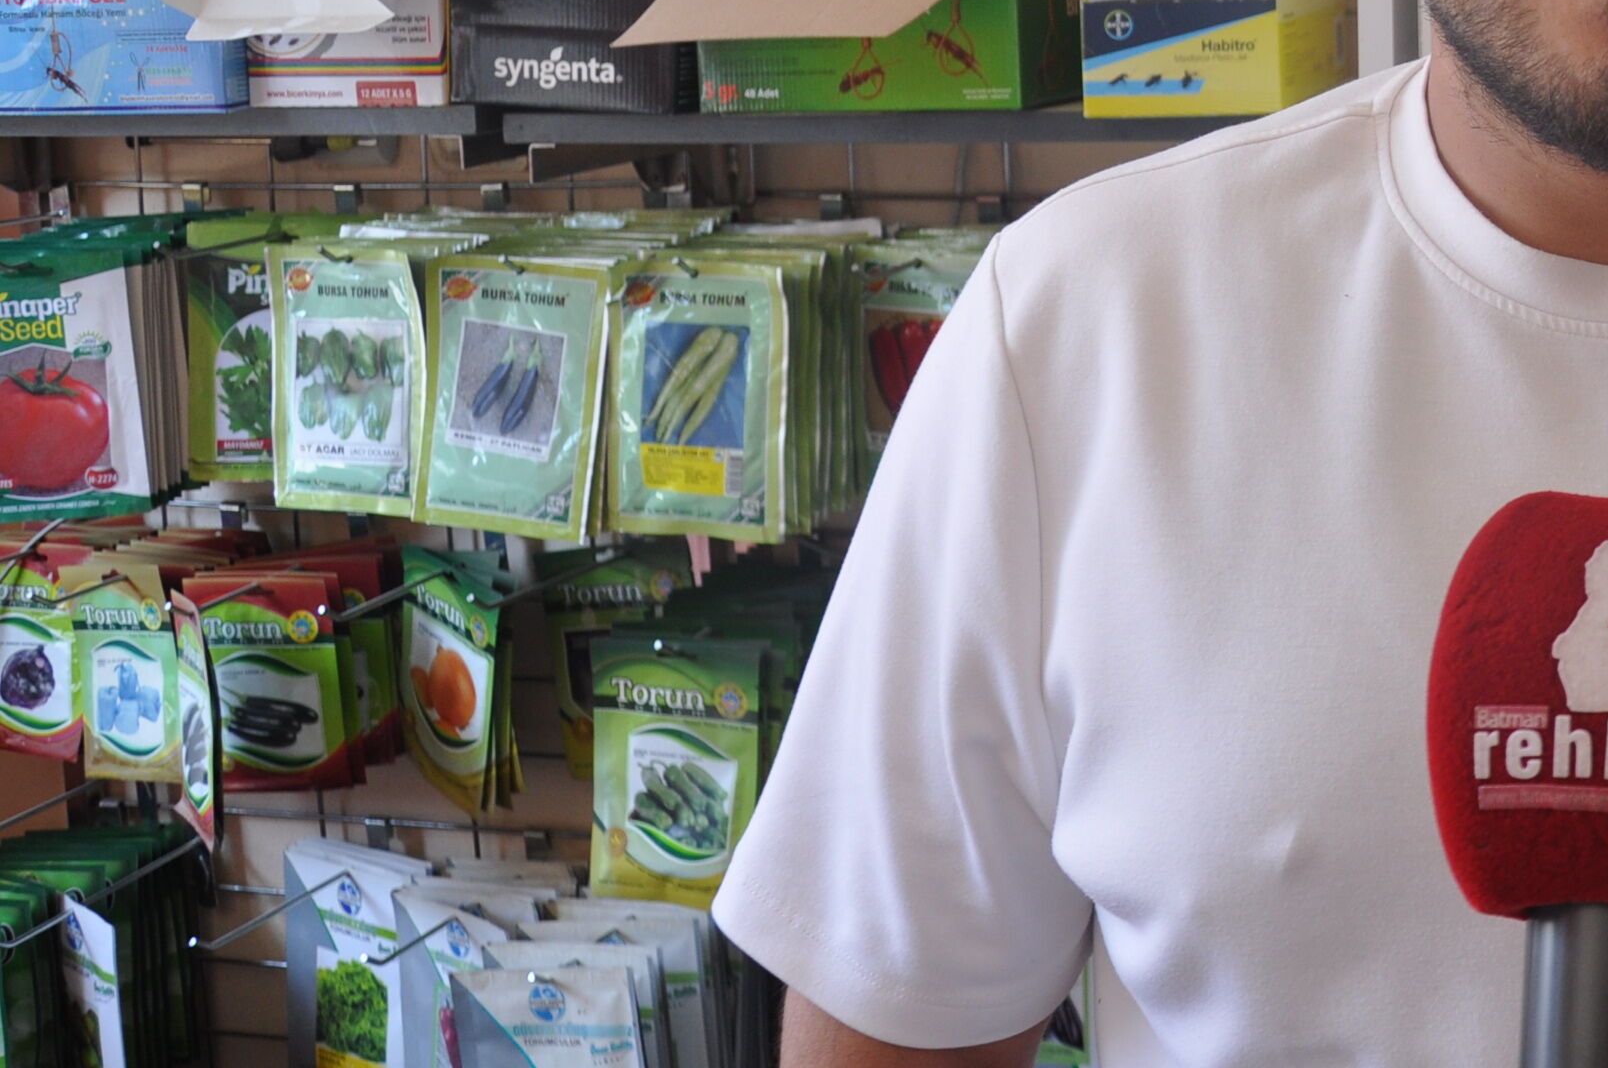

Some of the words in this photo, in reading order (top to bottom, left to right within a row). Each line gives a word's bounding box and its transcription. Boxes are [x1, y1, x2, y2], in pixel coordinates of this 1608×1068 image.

[1201, 39, 1255, 53] Habitro
[493, 54, 616, 89] syngenta
[361, 88, 369, 98] 12
[371, 88, 391, 98] ADET
[757, 87, 780, 100] Adet
[228, 267, 269, 295] Pin
[318, 285, 348, 298] BURSA
[351, 284, 389, 299] TOHUM
[481, 288, 522, 304] BURSA
[524, 293, 566, 308] TOHUM
[702, 293, 746, 307] TOHUM
[0, 315, 63, 341] Seed
[558, 582, 643, 605] Torun
[80, 604, 139, 625] Torun
[416, 584, 466, 631] Torun
[203, 617, 284, 640] Torun
[611, 677, 706, 711] Torun
[1476, 710, 1548, 729] Batman
